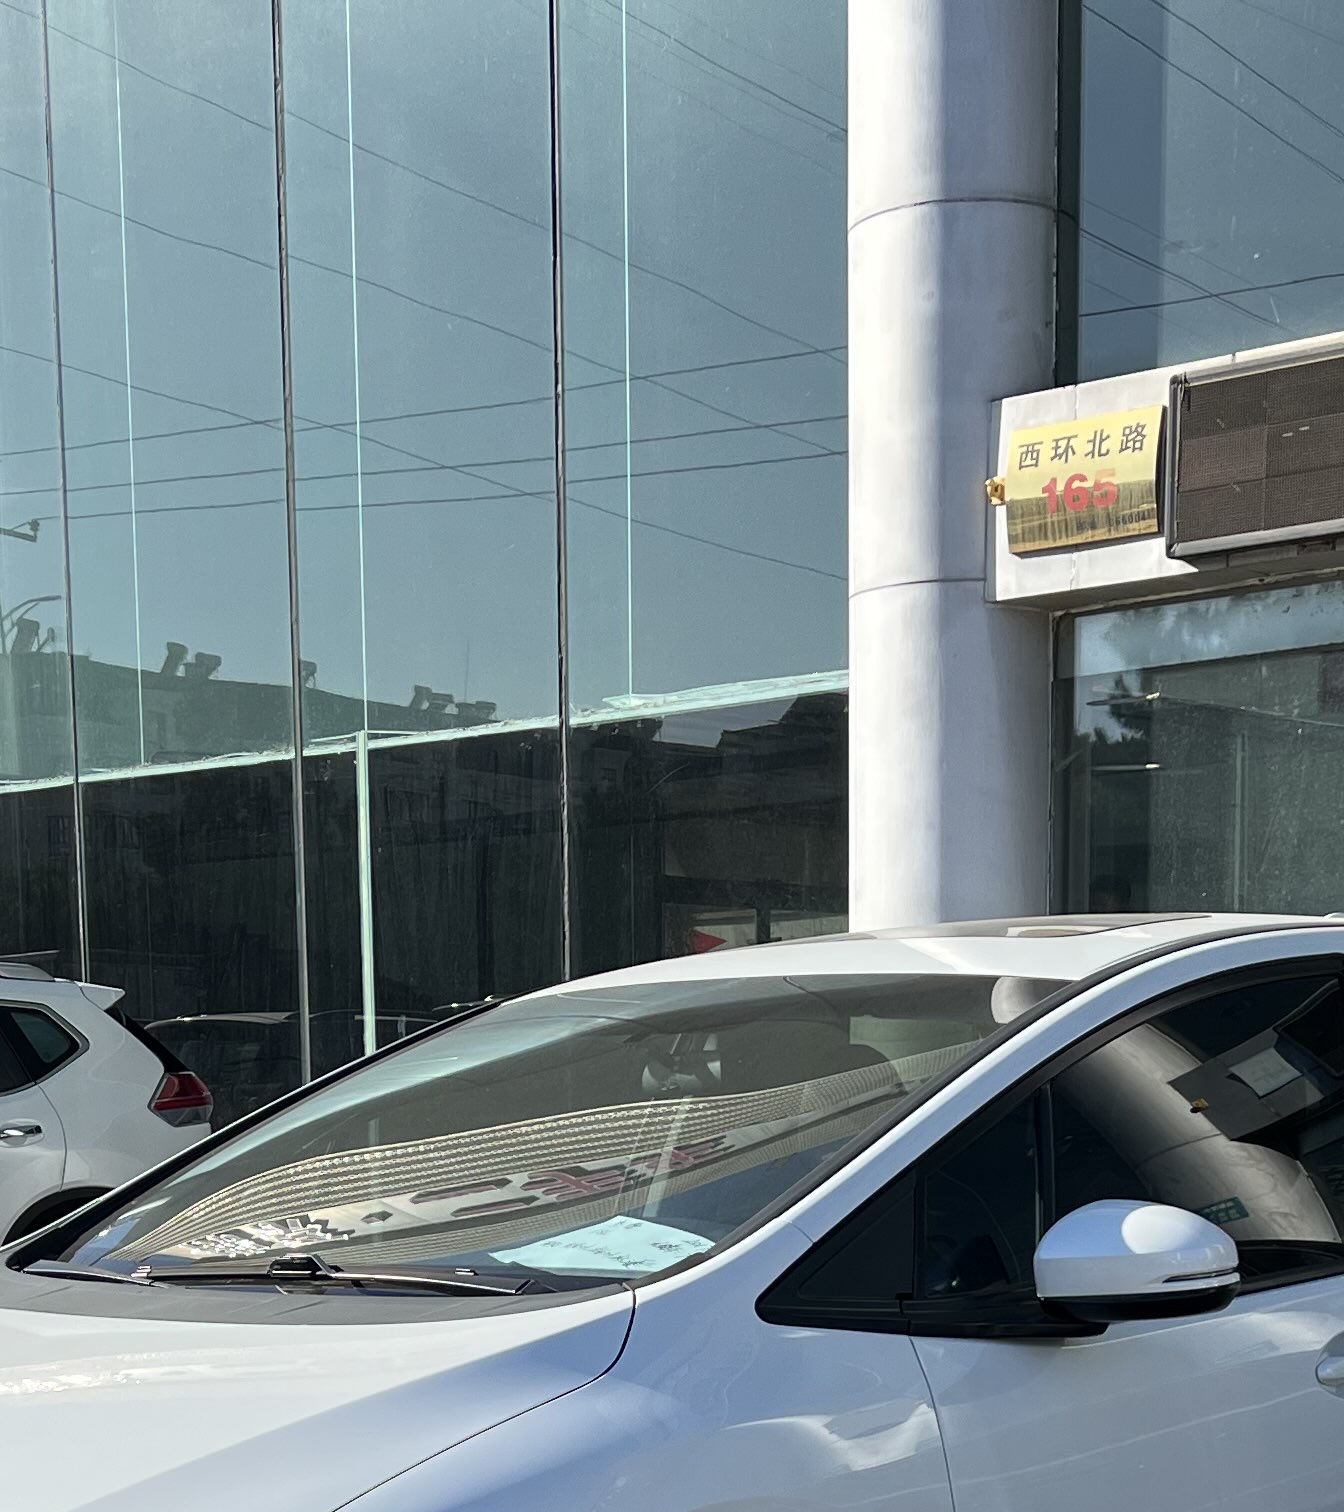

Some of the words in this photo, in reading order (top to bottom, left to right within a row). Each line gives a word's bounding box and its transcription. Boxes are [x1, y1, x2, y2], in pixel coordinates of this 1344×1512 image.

[1018, 422, 1147, 471] 西环北路
[1042, 468, 1120, 514] 165
